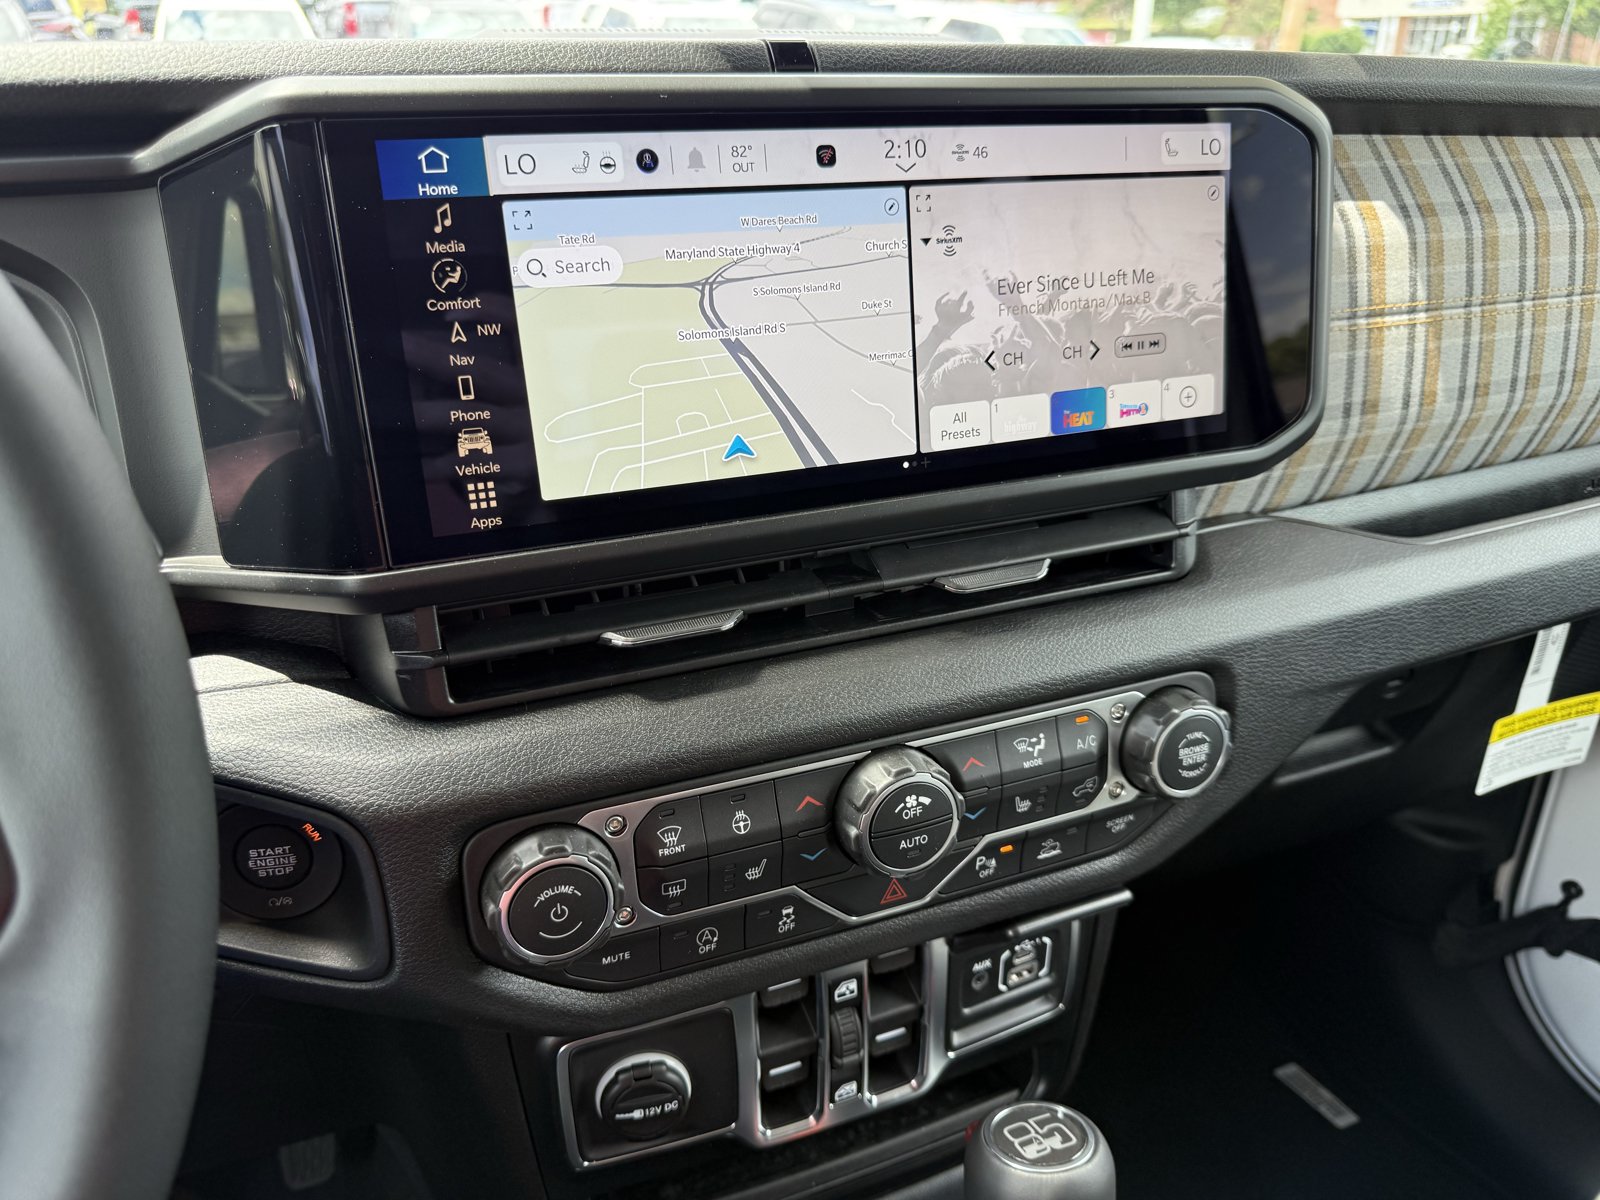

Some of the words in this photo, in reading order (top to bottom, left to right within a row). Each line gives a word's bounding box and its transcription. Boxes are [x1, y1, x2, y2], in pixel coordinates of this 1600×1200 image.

[731, 145, 753, 158] 82°
[884, 138, 927, 159] 2:10
[972, 146, 988, 159] 46
[1200, 138, 1222, 155] LO
[504, 153, 537, 175] LO
[733, 162, 755, 172] OUT
[418, 183, 458, 196] Home
[741, 218, 750, 226] W
[752, 217, 776, 226] Dares
[779, 215, 806, 225] Beach
[808, 215, 818, 224] Rd
[559, 235, 580, 245] Tate
[582, 234, 595, 244] Rd
[865, 241, 900, 251] Church
[426, 240, 466, 254] Media
[665, 249, 716, 261] Maryland
[718, 247, 745, 257] State
[747, 244, 791, 258] Highway
[792, 243, 800, 253] 4
[555, 257, 610, 274] Search
[753, 288, 760, 296] S
[760, 285, 801, 296] Solomons
[803, 284, 827, 293] Island
[829, 282, 841, 291] Rd
[997, 278, 1033, 297] Ever
[1037, 274, 1080, 293] Since
[1083, 273, 1095, 289] U
[1100, 270, 1128, 288] Left
[1131, 268, 1155, 284] Me
[427, 297, 481, 312] Comfort
[862, 300, 882, 310] Duke
[883, 300, 893, 309] St
[998, 300, 1044, 318] French
[1141, 291, 1151, 304] B
[477, 324, 501, 336] NW
[678, 328, 730, 341] Solomons
[732, 325, 761, 336] Island
[764, 324, 778, 334] Rd
[780, 323, 786, 332] S
[869, 351, 906, 361] Merrimac
[1003, 352, 1023, 366] CH
[1062, 346, 1083, 360] CH
[450, 354, 475, 366] Nav
[1164, 383, 1170, 392] 4
[1110, 390, 1115, 399] 3
[450, 408, 491, 423] Phone
[953, 411, 967, 424] All
[1063, 411, 1095, 428] HEAT
[940, 426, 981, 441] Presets
[455, 461, 500, 476] Vehicle
[470, 515, 503, 530] Apps
[1076, 734, 1097, 749] A/C
[1186, 732, 1204, 740] TUNE
[1179, 743, 1209, 756] BROWSE
[1023, 758, 1043, 769] MODE
[1183, 754, 1206, 766] ENTER
[902, 805, 923, 819] OFF
[1106, 814, 1134, 828] SCREEN
[302, 823, 322, 842] RUN
[1111, 823, 1126, 833] OFF
[899, 834, 928, 850] AUTO
[249, 845, 291, 857] START
[658, 844, 686, 857] FRONT
[248, 855, 298, 868] ENGINE
[258, 867, 294, 877] STOP
[979, 868, 995, 878] OFF
[537, 885, 575, 901] VOLUME
[778, 922, 795, 933] OFF
[698, 942, 717, 954] OFF
[602, 951, 631, 964] MUTE
[972, 958, 992, 972] AUX
[645, 1105, 662, 1116] 12V
[664, 1100, 678, 1111] DC
